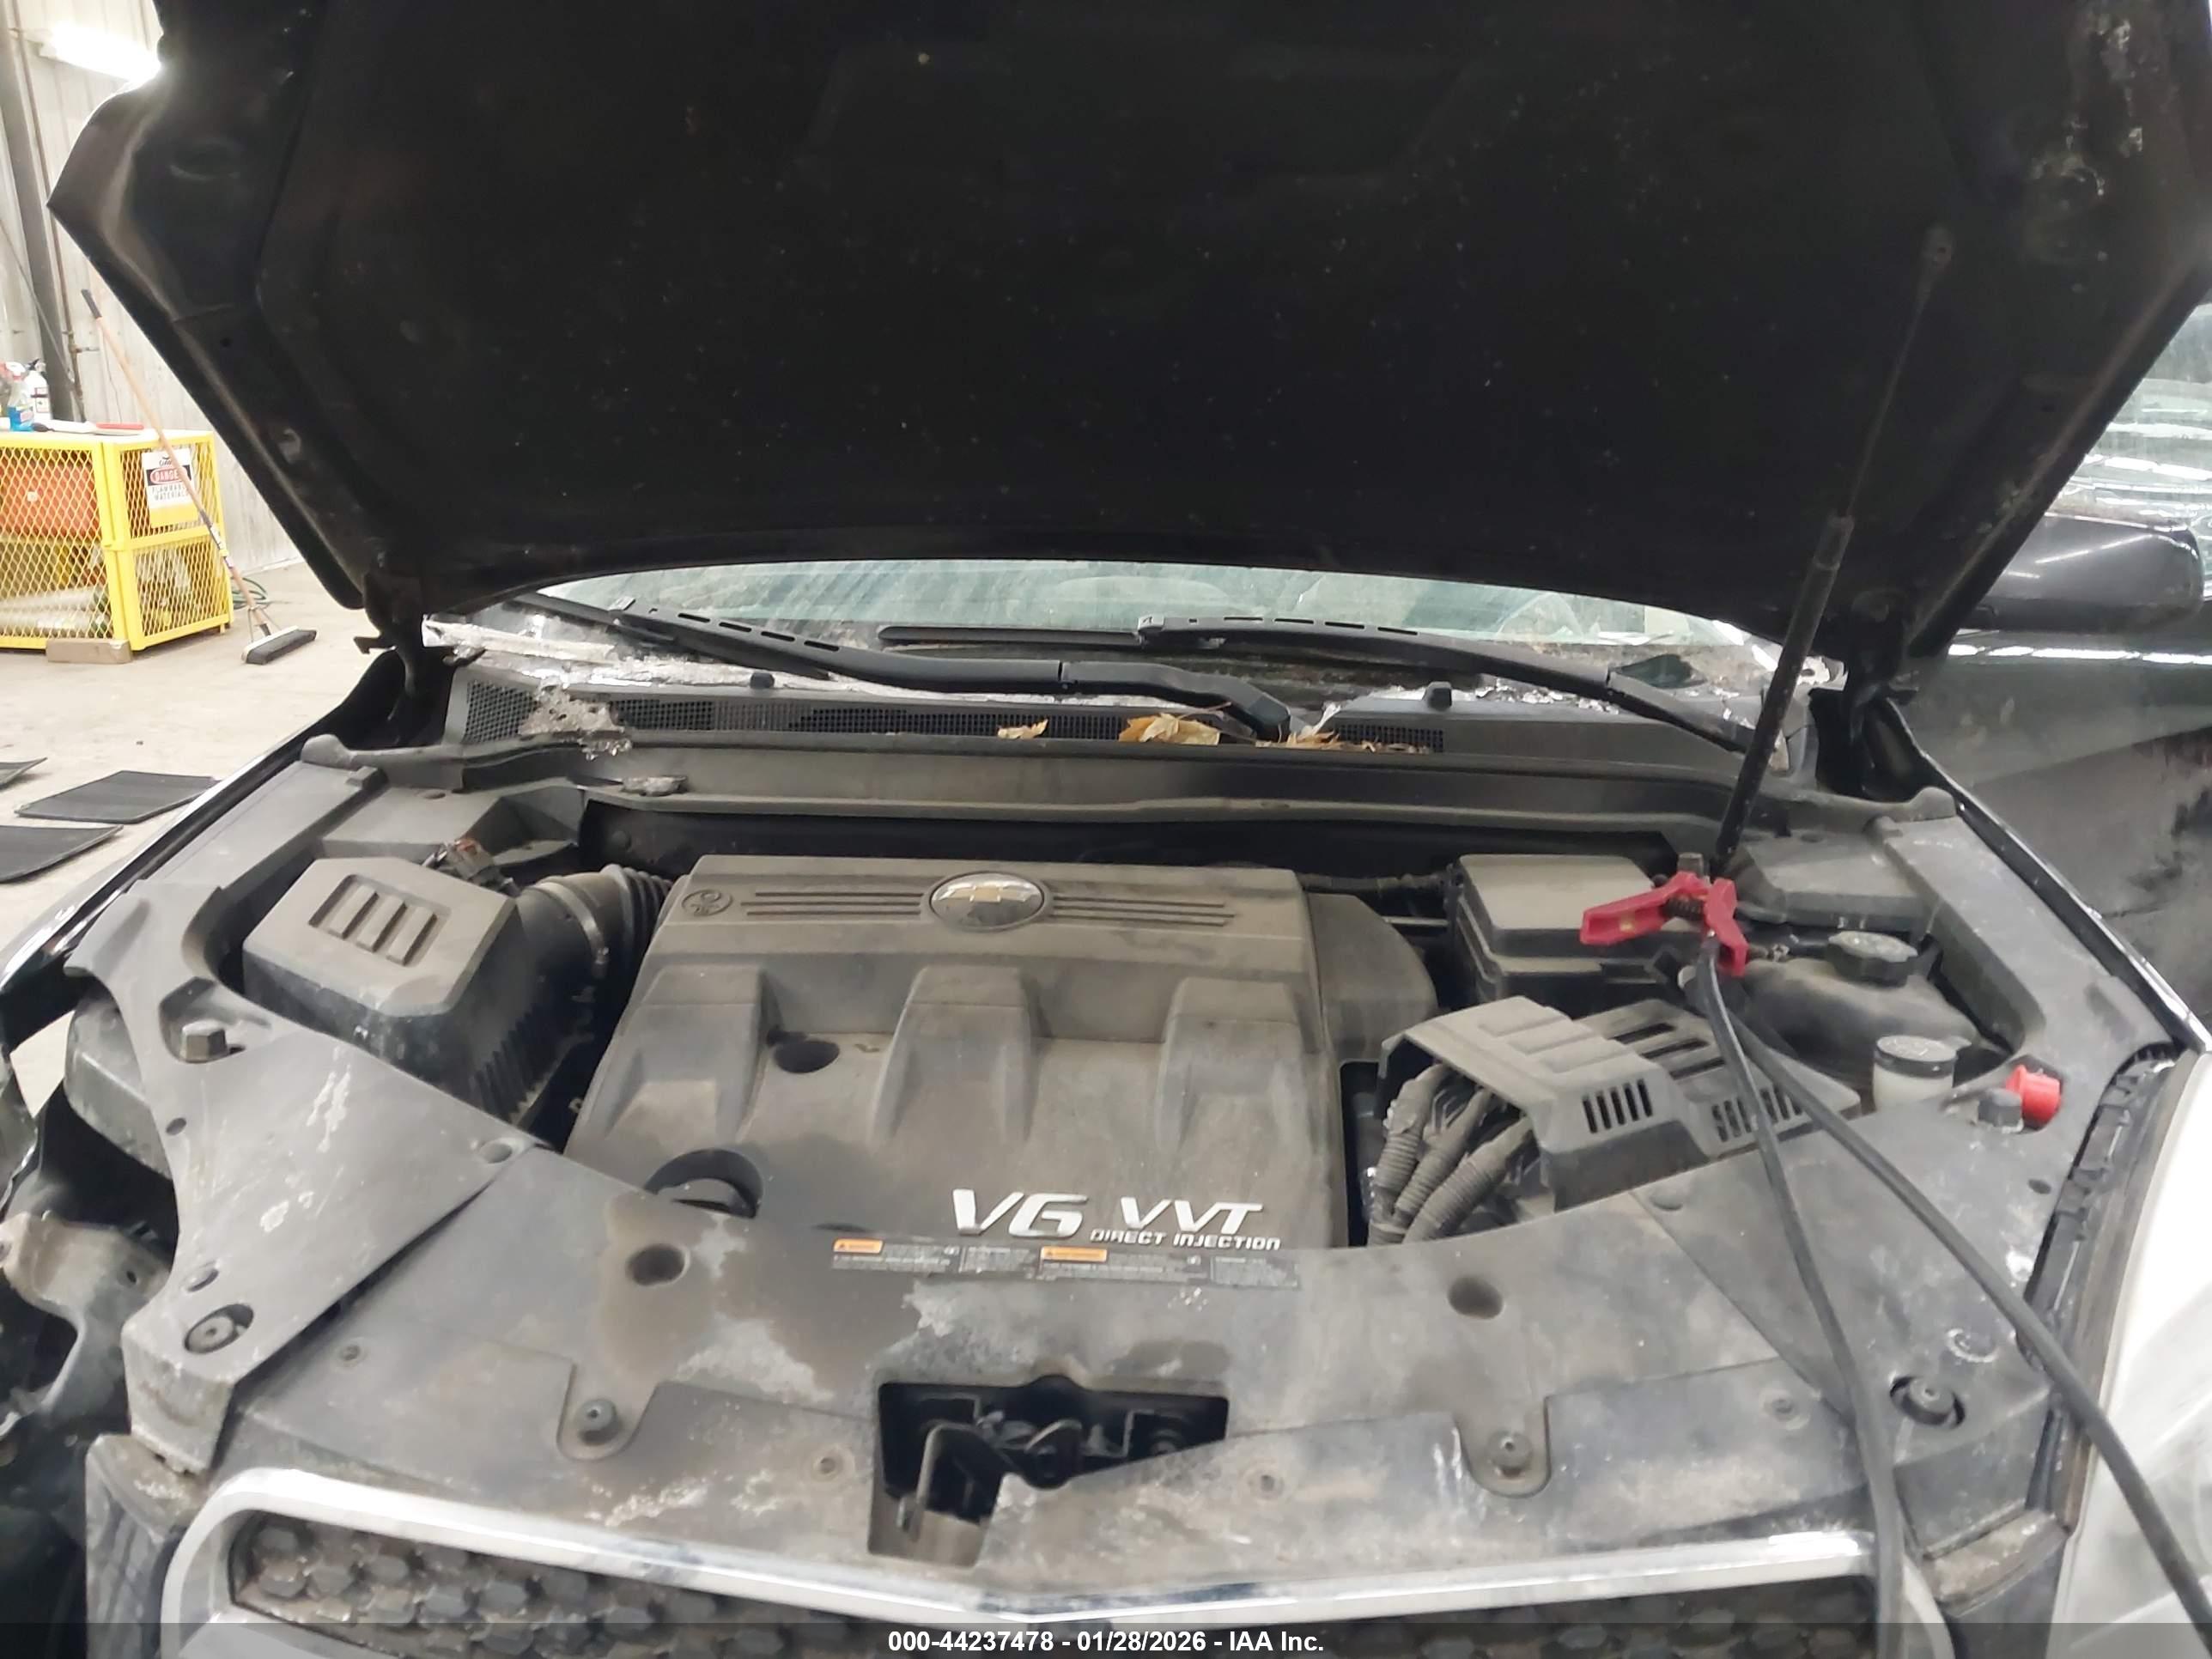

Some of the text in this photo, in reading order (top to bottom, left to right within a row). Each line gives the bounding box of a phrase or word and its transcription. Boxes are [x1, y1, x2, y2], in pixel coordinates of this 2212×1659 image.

[155, 469, 180, 482] DANGE
[952, 1188, 1263, 1237] V6 VVT
[1090, 1229, 1281, 1251] DIRECT INJECTION
